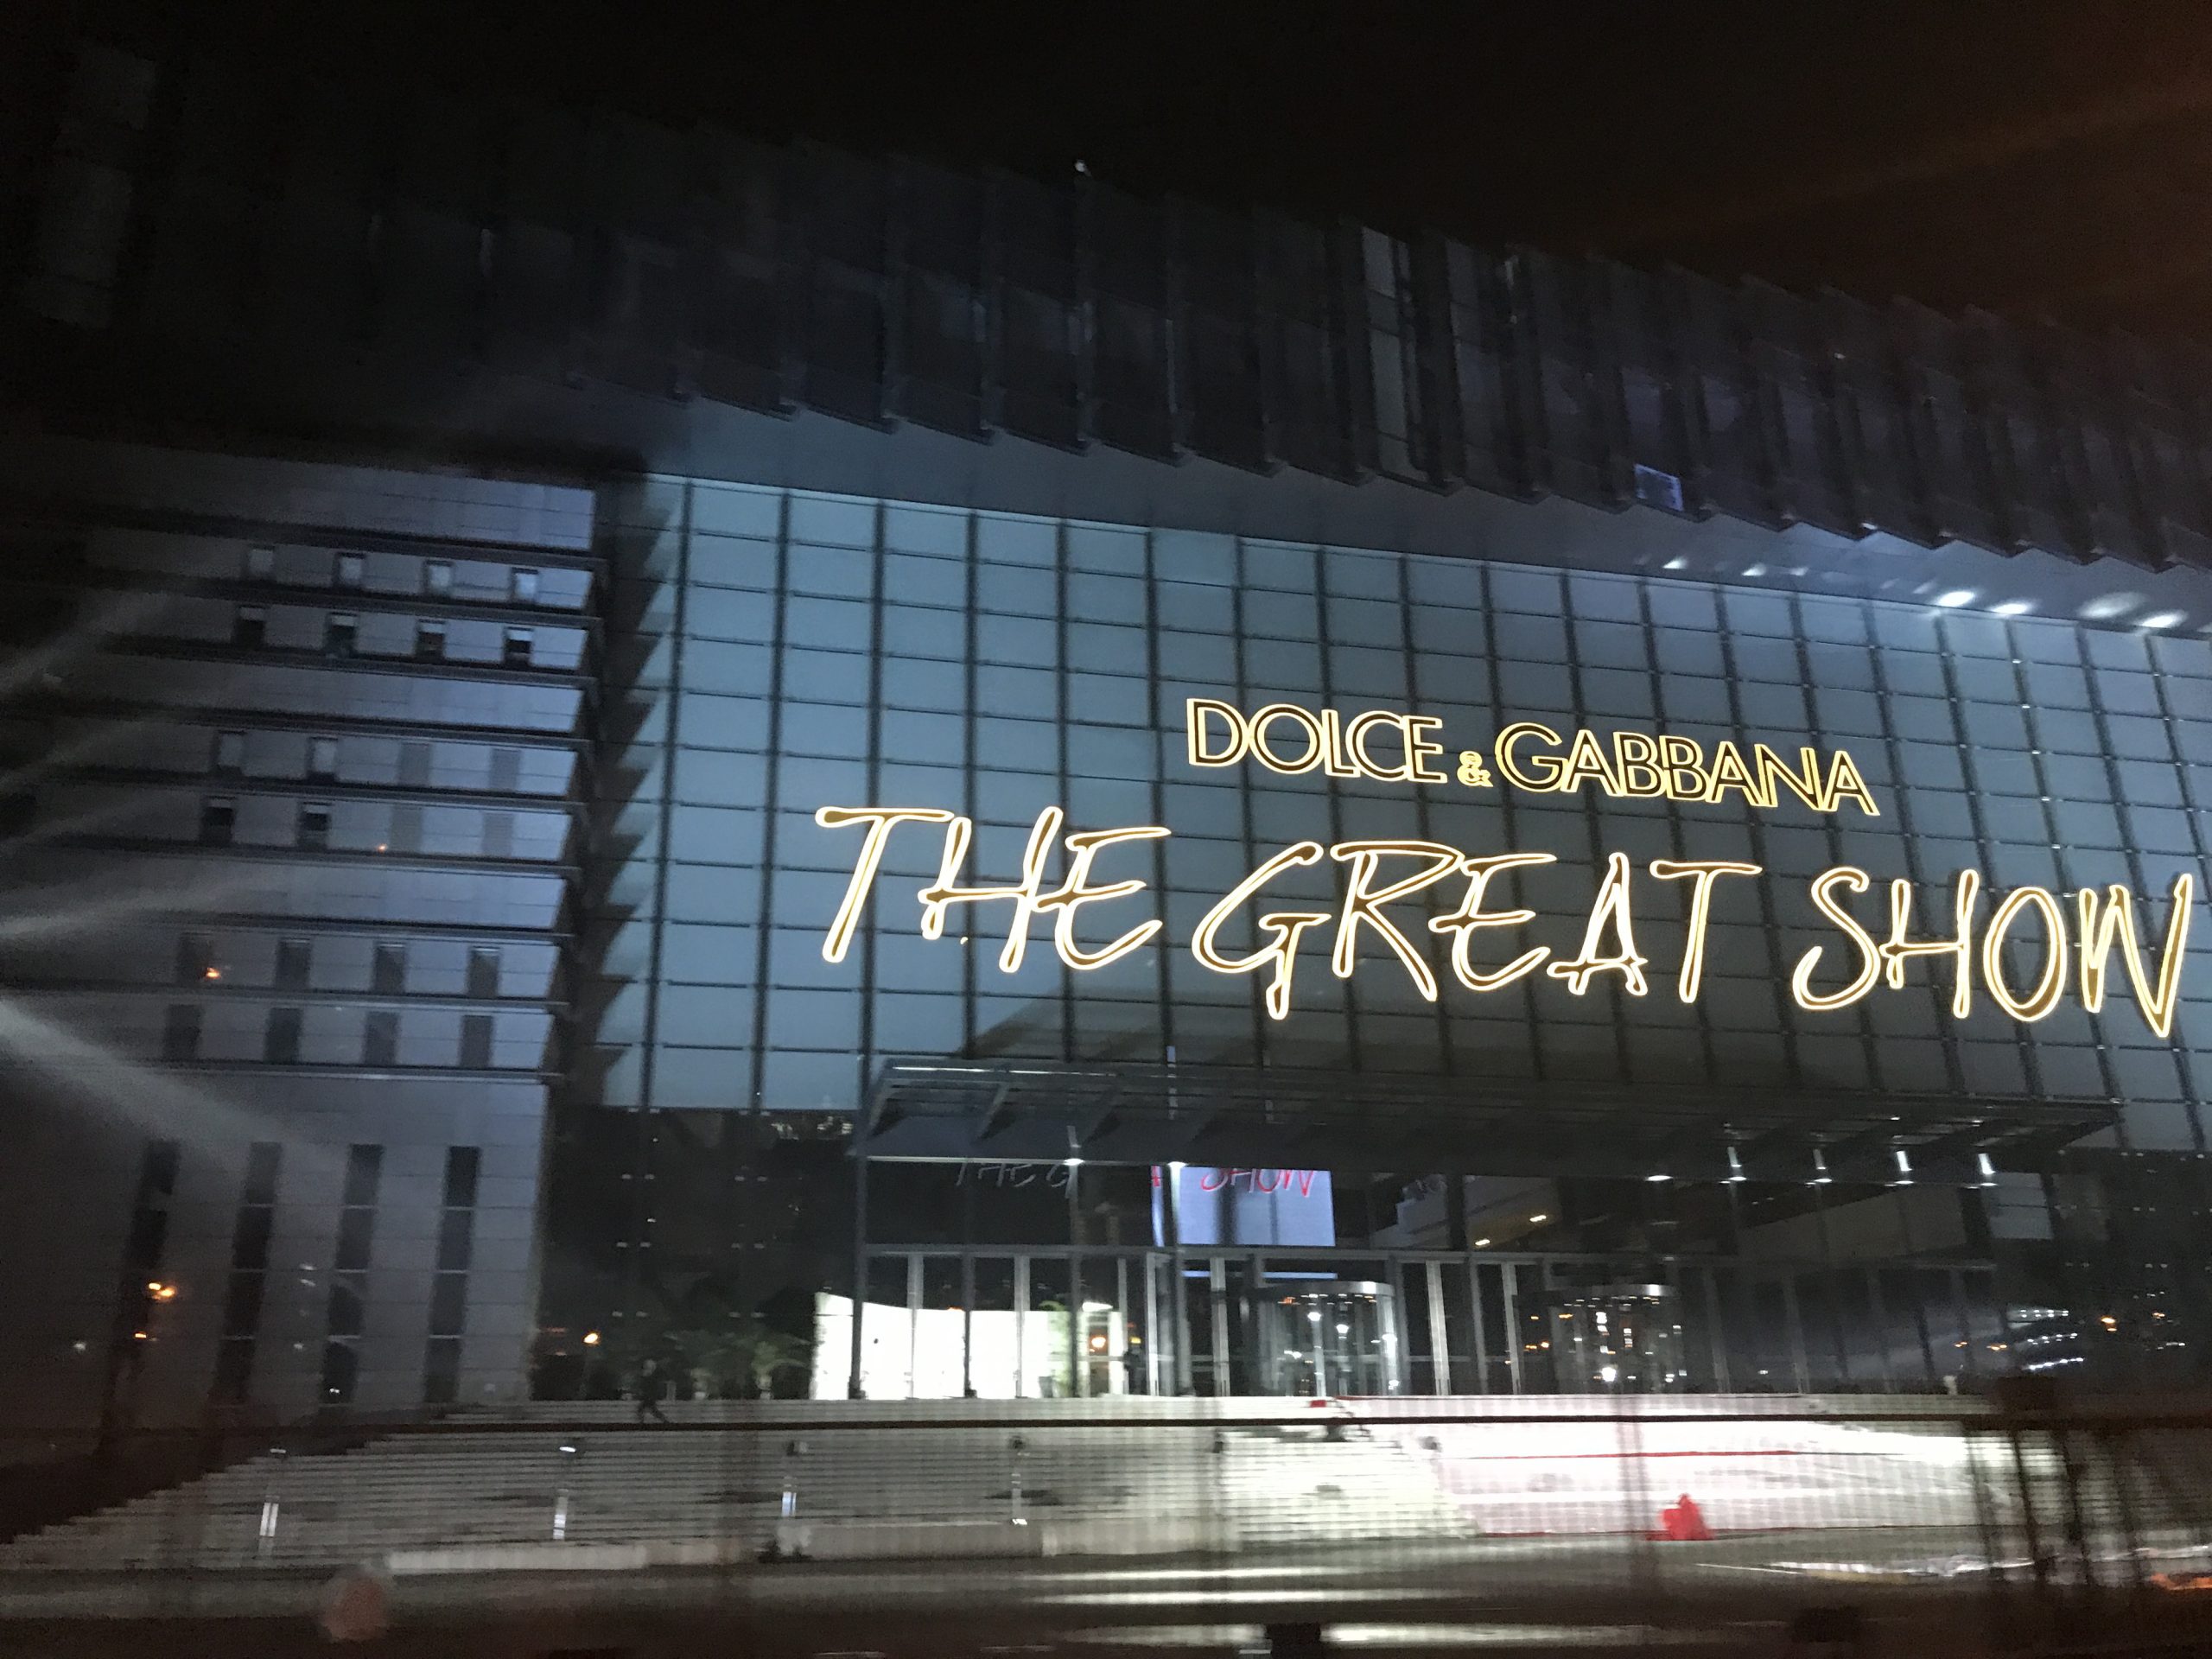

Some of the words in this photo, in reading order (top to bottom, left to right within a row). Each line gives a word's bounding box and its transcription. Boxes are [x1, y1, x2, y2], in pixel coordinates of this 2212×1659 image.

[1186, 698, 1447, 784] DOLCE
[1458, 751, 1494, 788] &
[1495, 722, 1881, 817] GABBANA
[815, 806, 1172, 974] THE
[1192, 841, 1762, 1020] GREAT
[1791, 849, 2193, 1039] SHOW
